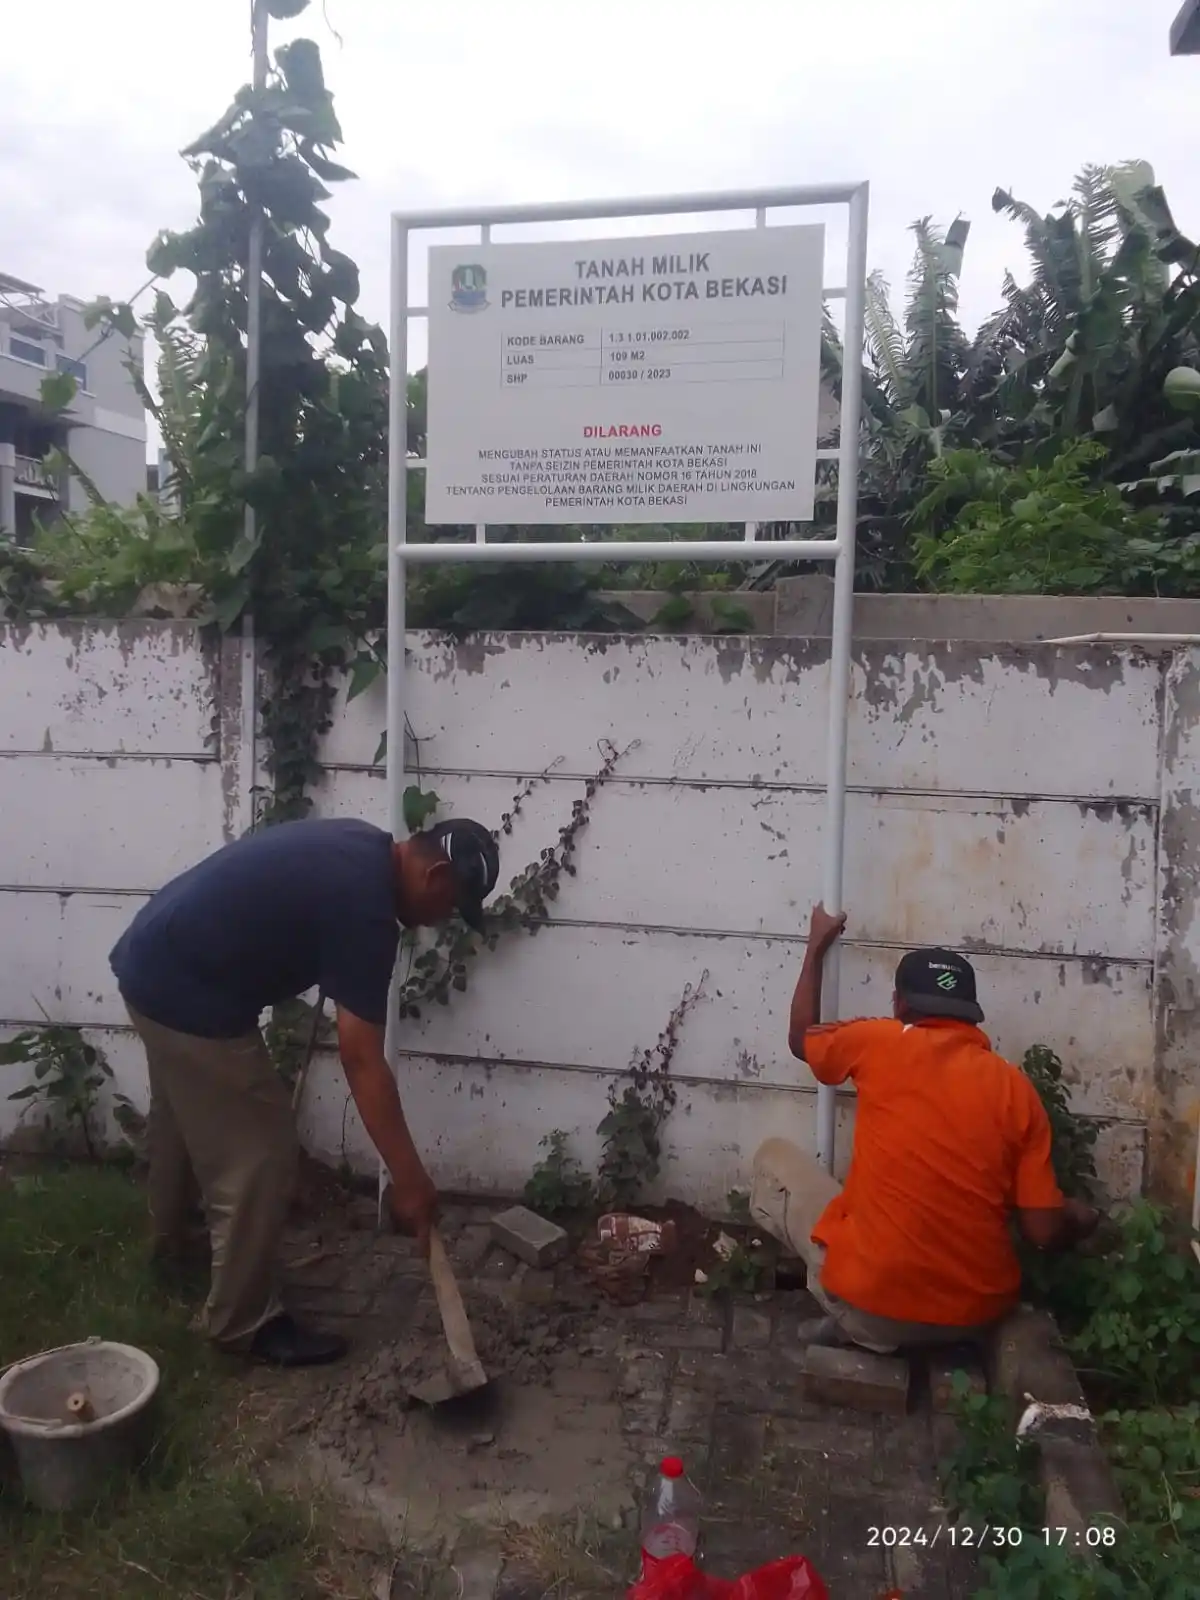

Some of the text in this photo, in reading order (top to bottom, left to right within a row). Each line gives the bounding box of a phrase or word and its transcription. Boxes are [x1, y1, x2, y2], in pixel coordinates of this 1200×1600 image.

[575, 253, 710, 279] TANAH MILIK
[501, 275, 787, 308] PEMERINTAH KOTA BEKASI
[507, 336, 536, 346] KODE
[539, 334, 585, 345] BARANG
[507, 355, 534, 365] LUAS
[631, 351, 645, 360] M2
[506, 374, 527, 384] SHP
[608, 370, 638, 380] 00030
[647, 368, 671, 379] 2023
[583, 424, 662, 438] DILARANG
[478, 444, 762, 459] MENGUBAH STATUS ATAU MEMANFAATKAN TANAH INI
[510, 457, 727, 470] TANPA SEIZIN PEMERINTAH KOTA BEKASI
[481, 469, 757, 483] SESUAI PERATURAN DAERAH NOMOR 16 TAHUN 2018
[446, 480, 795, 495] TENTANG PENGELOLAAN BARANG MILIK DAERAH DI LINGKUNGAN
[545, 495, 687, 507] PEMERINTAH KOTA BEKASI
